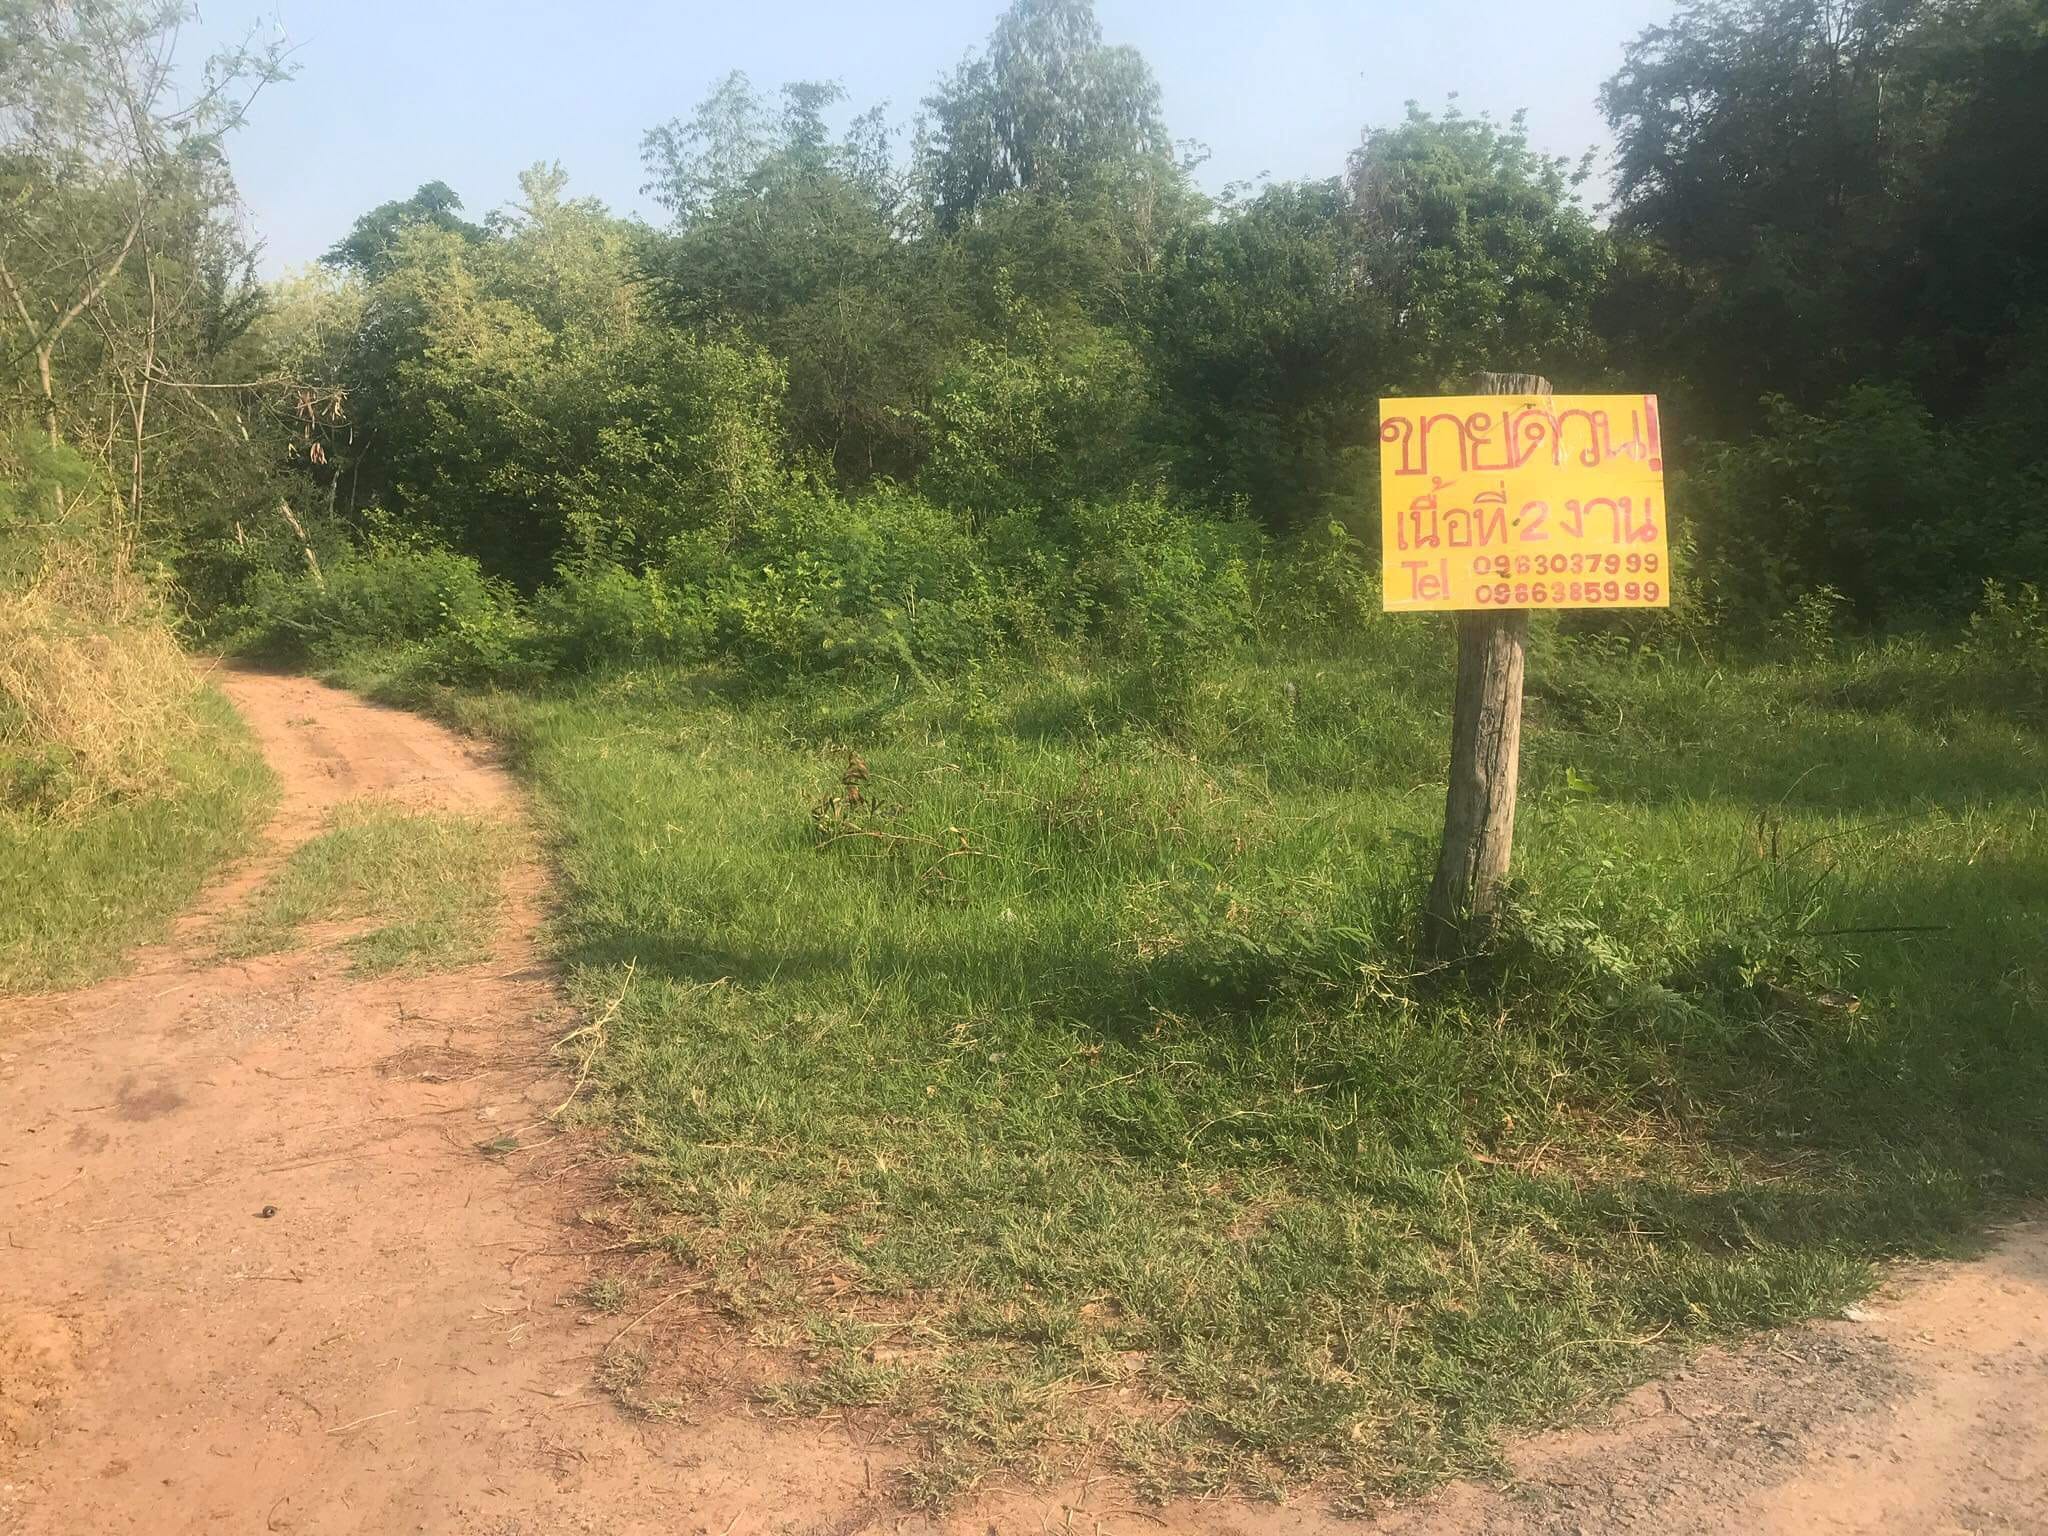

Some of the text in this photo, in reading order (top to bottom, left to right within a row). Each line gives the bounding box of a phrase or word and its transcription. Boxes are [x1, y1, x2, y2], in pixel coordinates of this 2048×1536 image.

[1398, 476, 1658, 550] เนื้อที่ 2 งาน
[1401, 553, 1658, 601] Tel 0963037999
